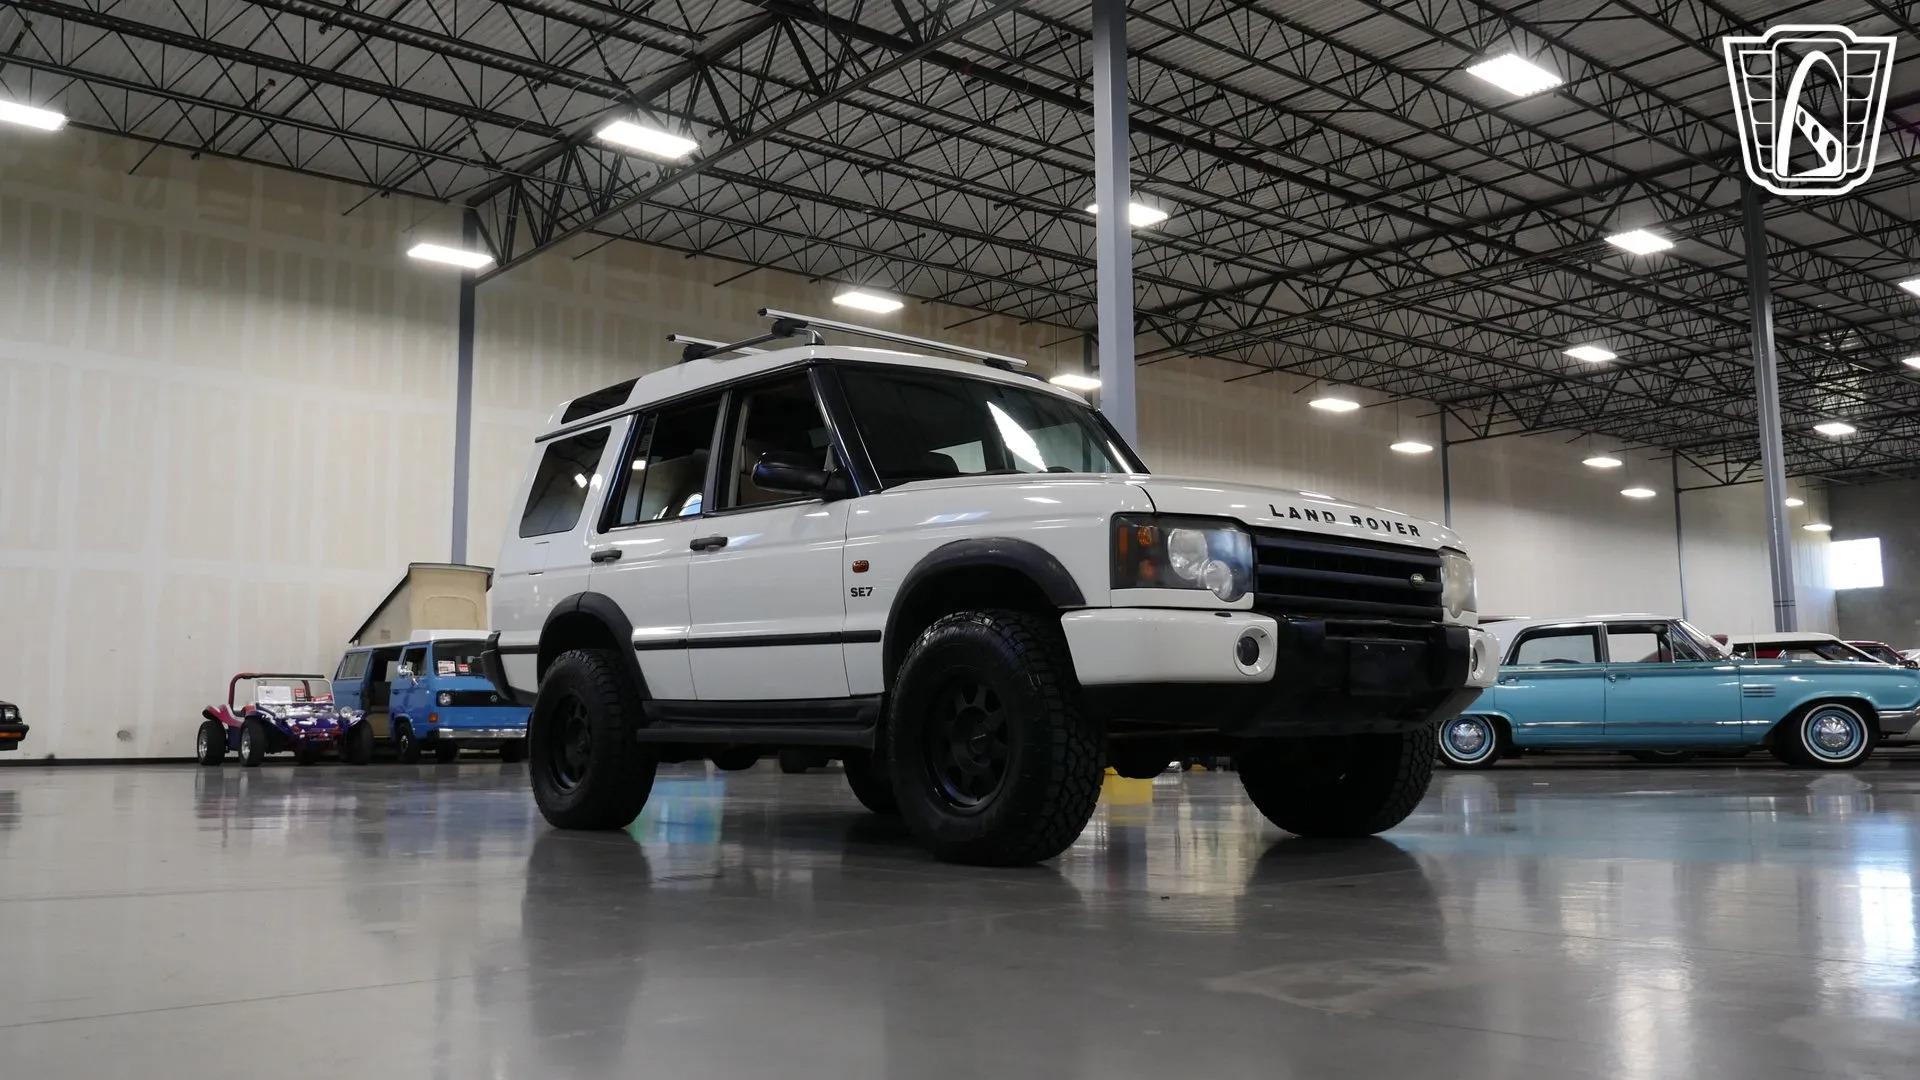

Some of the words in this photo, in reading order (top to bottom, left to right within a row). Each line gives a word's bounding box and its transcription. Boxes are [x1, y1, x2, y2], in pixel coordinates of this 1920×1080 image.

[1269, 503, 1336, 523] LAND
[1349, 514, 1421, 537] ROVER
[850, 586, 874, 598] SE7
